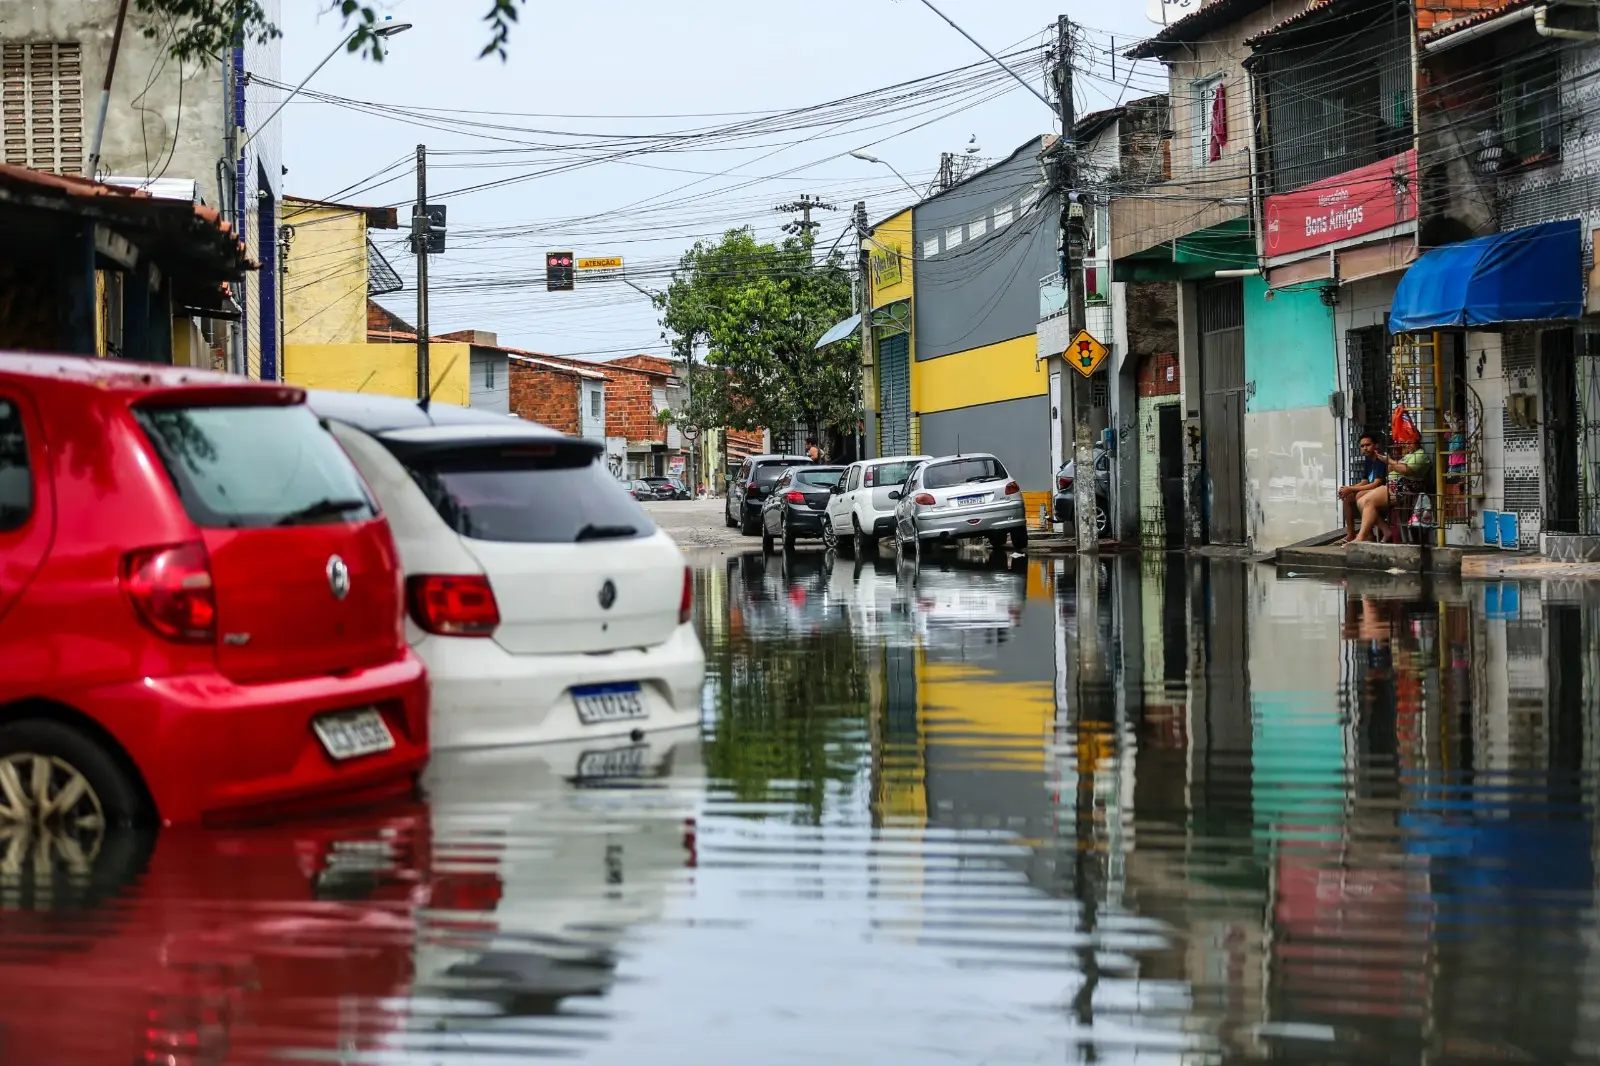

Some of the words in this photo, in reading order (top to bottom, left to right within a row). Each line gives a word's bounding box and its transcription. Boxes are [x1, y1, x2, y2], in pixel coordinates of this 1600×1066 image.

[1305, 215, 1327, 237] Bons
[1329, 204, 1363, 231] Amigos
[584, 259, 616, 267] ATENÇÃO
